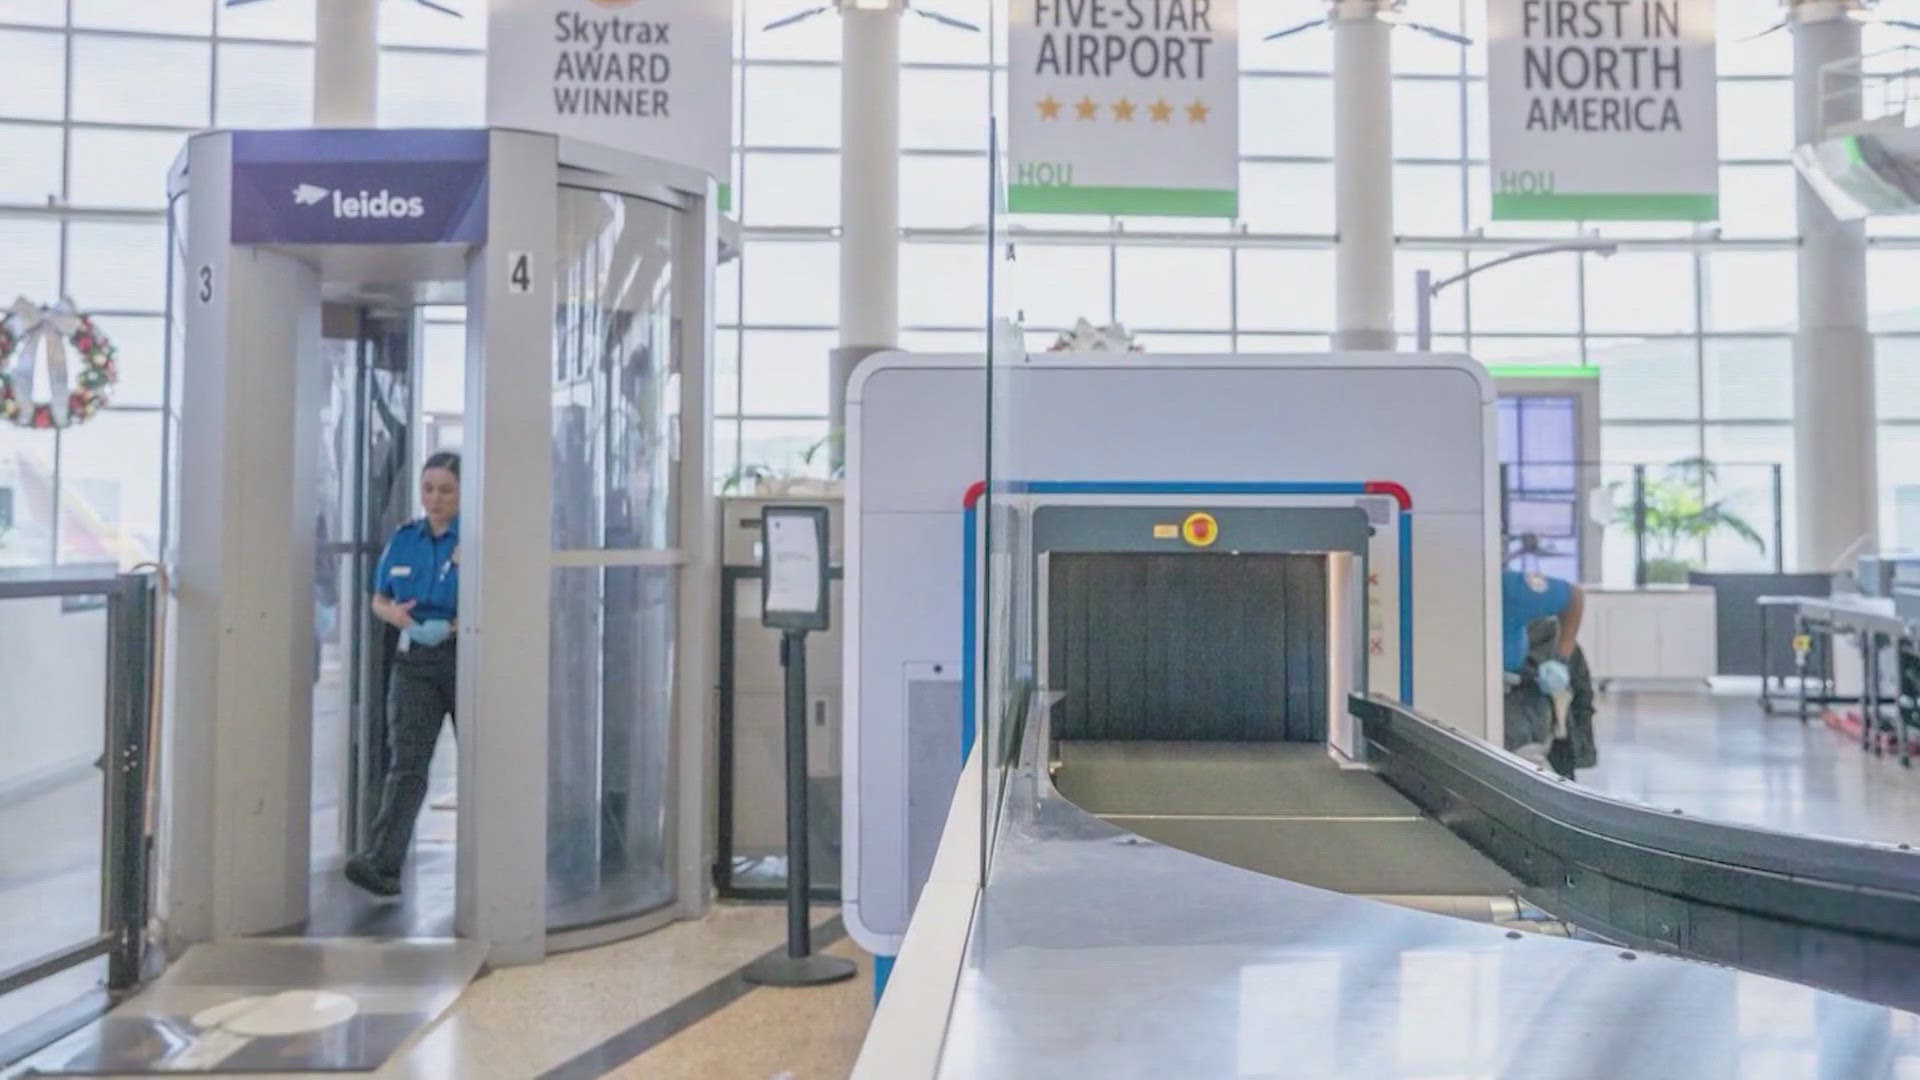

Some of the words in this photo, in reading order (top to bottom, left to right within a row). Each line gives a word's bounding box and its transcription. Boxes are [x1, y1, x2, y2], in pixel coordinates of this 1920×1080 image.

[555, 11, 670, 51] Skytrax
[1034, 0, 1211, 31] FIVE-STAR
[1522, 0, 1630, 38] FIRST
[1643, 0, 1680, 37] IN
[554, 51, 670, 83] AWARD
[1035, 34, 1212, 79] AIRPORT
[1524, 46, 1682, 90] NORTH
[553, 86, 670, 117] WINNER
[1525, 96, 1682, 131] AMERICA
[1016, 161, 1073, 187] HOU
[1500, 168, 1555, 195] HOU
[332, 190, 425, 219] leidos
[200, 265, 213, 302] 3
[511, 255, 531, 292] 4
